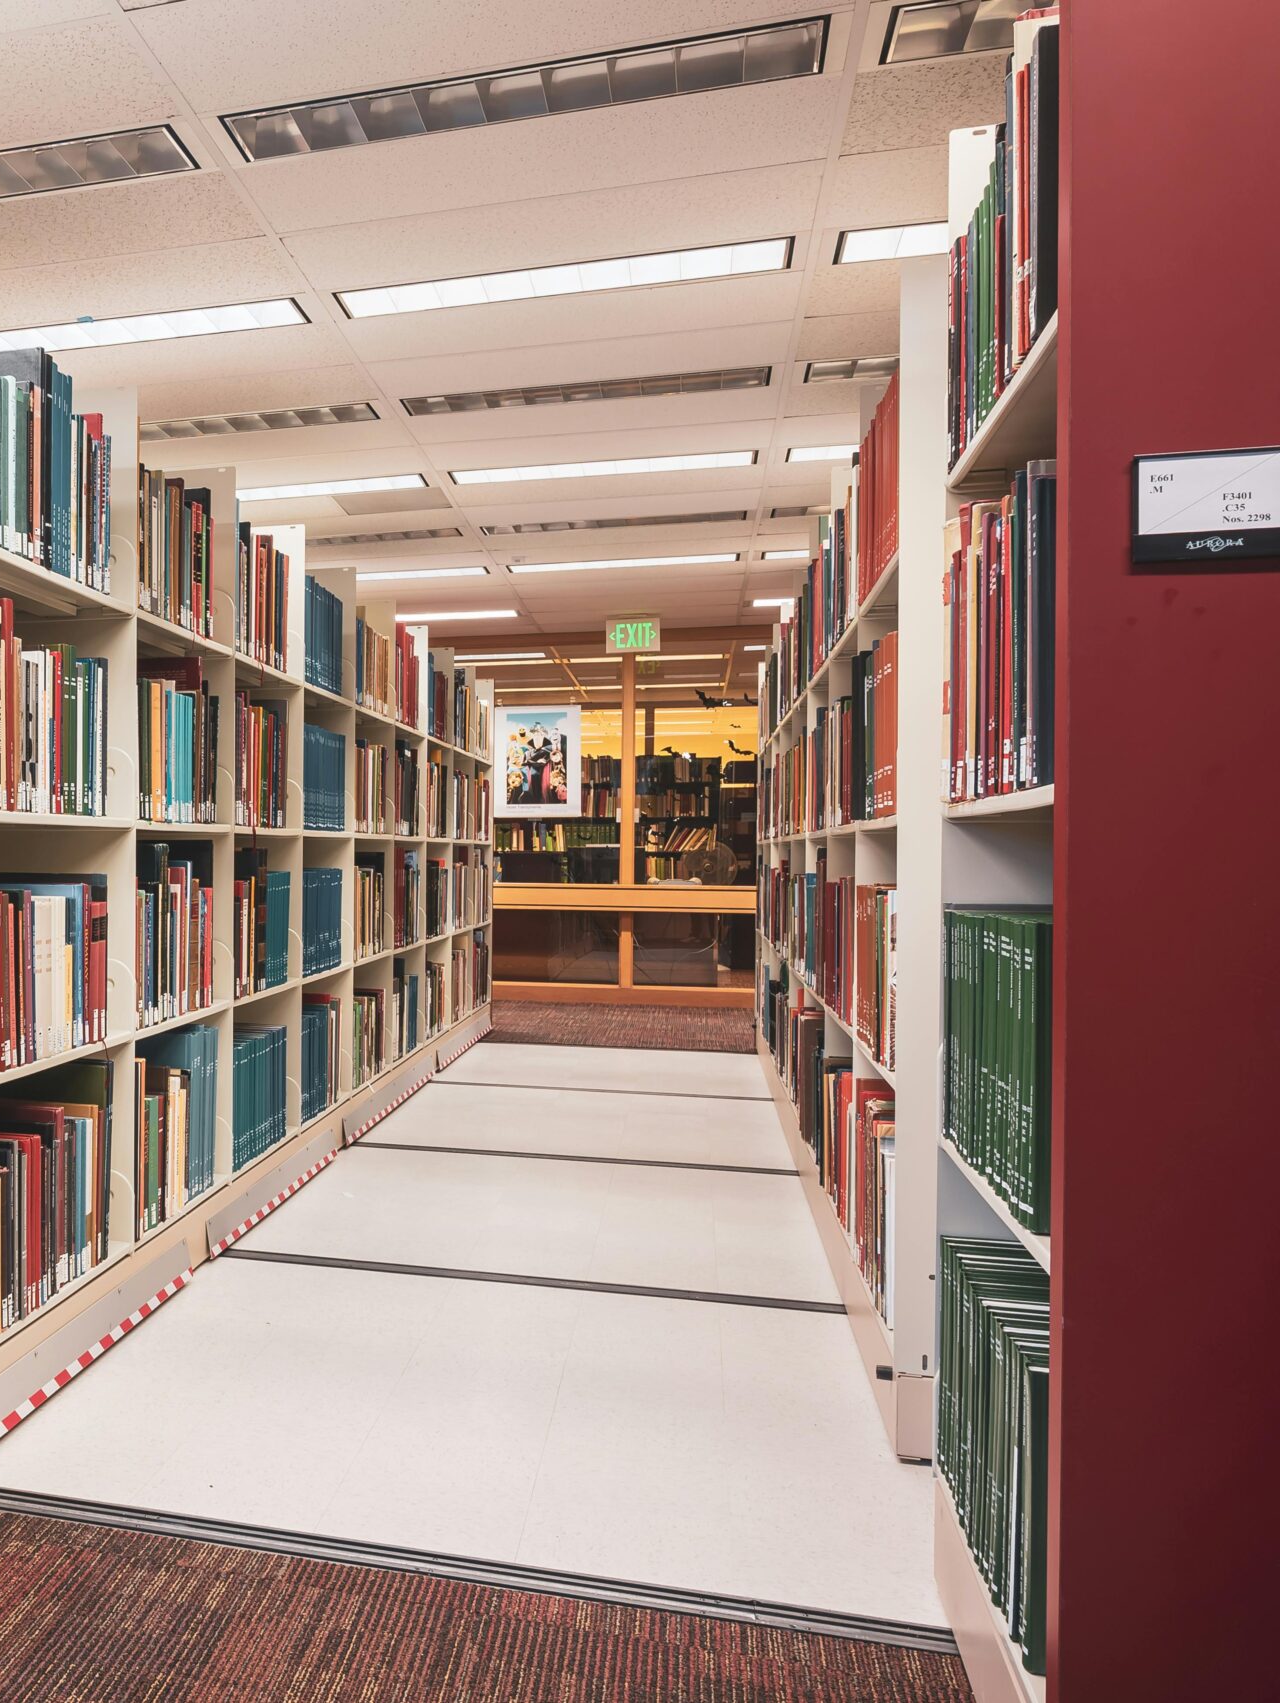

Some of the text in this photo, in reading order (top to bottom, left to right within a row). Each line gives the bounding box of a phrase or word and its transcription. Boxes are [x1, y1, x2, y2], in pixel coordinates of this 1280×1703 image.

[1150, 474, 1174, 483] E661
[1149, 486, 1163, 494] .M
[1222, 491, 1253, 501] F3401
[1222, 503, 1246, 512] .C35
[1222, 513, 1271, 523] Nos. 2298
[1186, 536, 1244, 552] AURORA
[616, 622, 652, 649] EXIT
